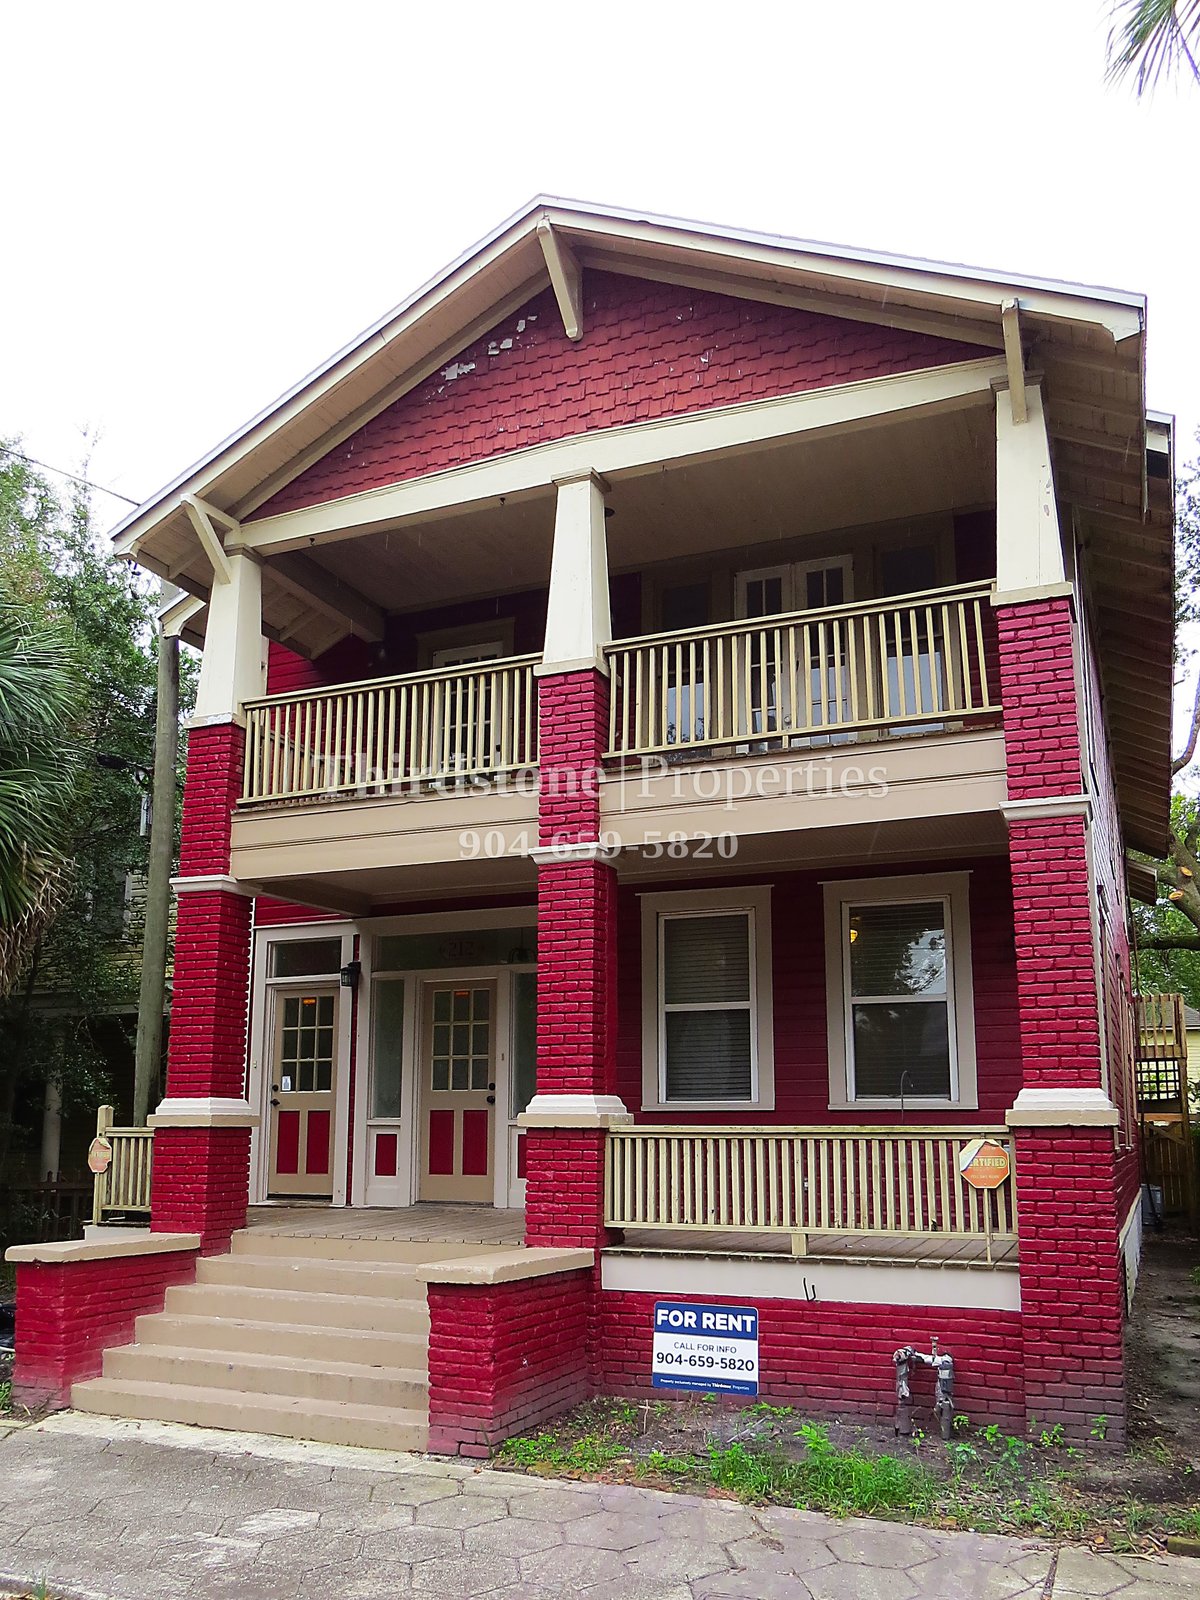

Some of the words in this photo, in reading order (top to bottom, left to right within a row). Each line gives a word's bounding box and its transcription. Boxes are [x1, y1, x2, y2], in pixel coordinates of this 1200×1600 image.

[969, 1157, 1006, 1167] RTIFIED
[656, 1309, 697, 1328] FOR
[702, 1312, 756, 1332] RENT
[673, 1341, 695, 1351] CALL
[697, 1343, 715, 1352] FOR
[716, 1345, 737, 1354] INFO
[656, 1352, 755, 1371] 904-659-5820
